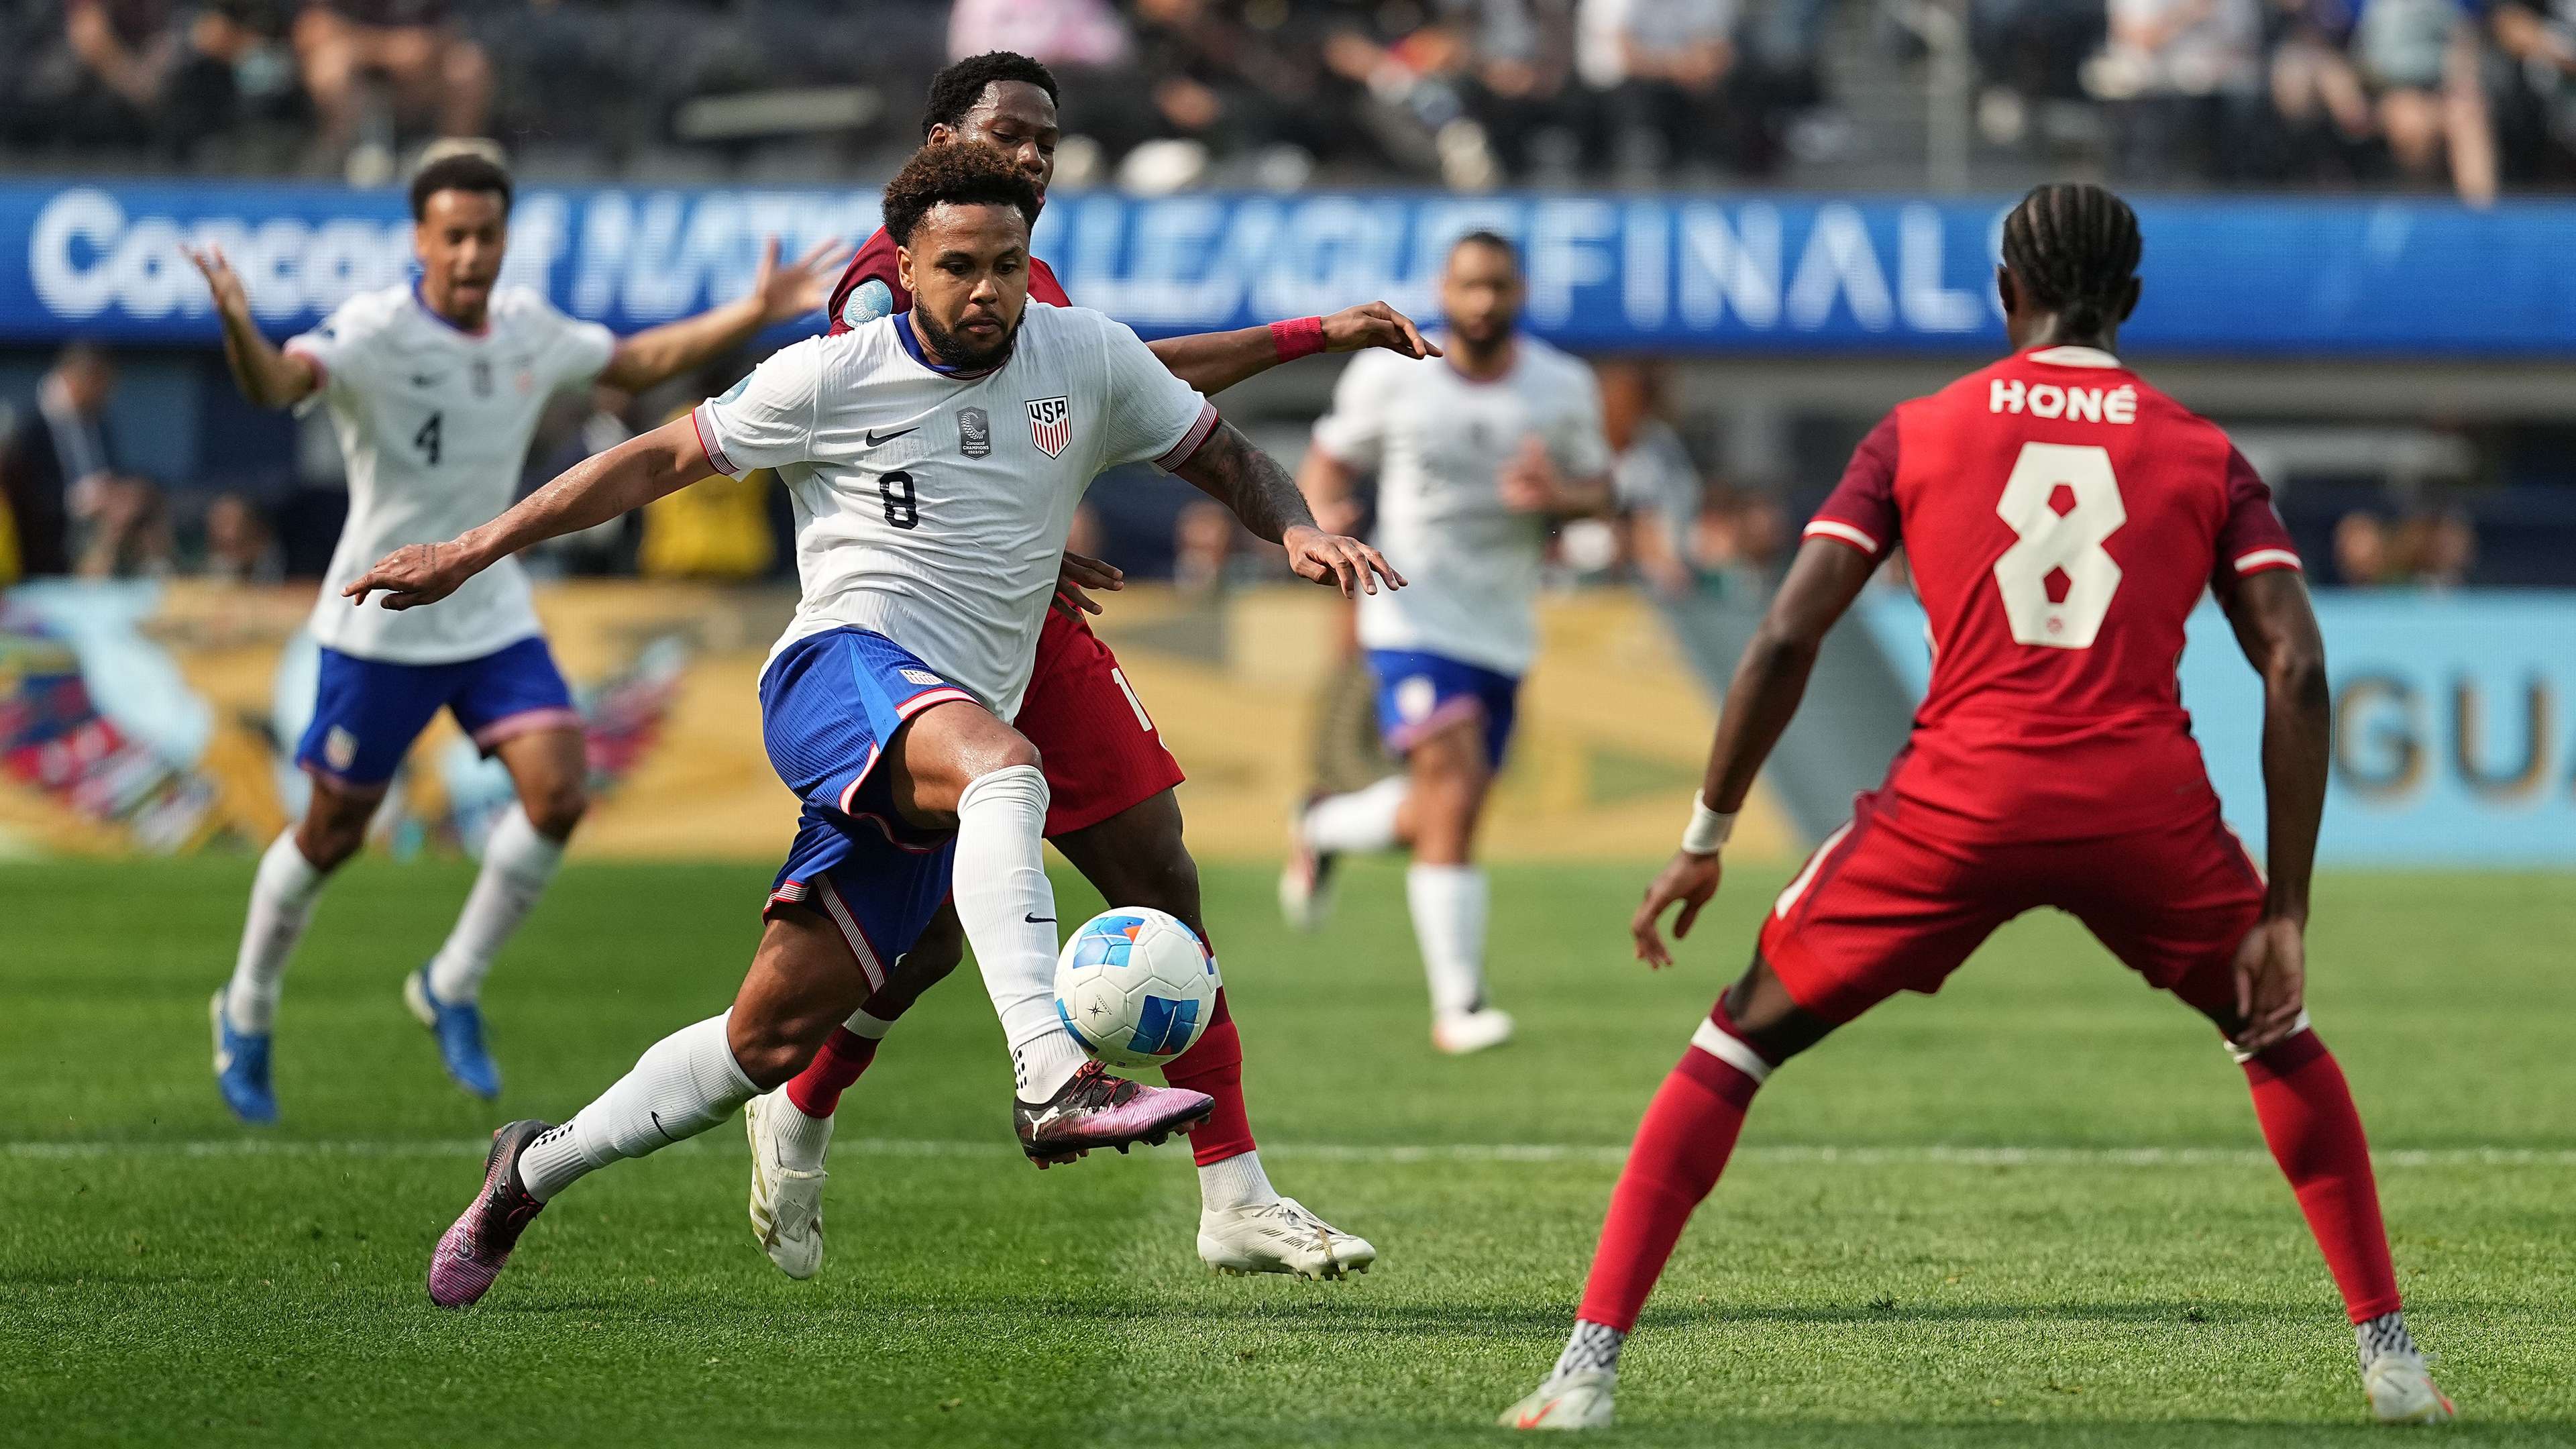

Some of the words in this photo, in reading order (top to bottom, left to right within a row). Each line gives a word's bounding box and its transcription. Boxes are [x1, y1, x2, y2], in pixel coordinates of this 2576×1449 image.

[1525, 197, 2007, 333] FINAL
[413, 407, 443, 468] 4
[1029, 400, 1066, 424] USA
[879, 471, 919, 530] 8
[1993, 441, 2127, 648] 8
[2333, 672, 2576, 810] GU
